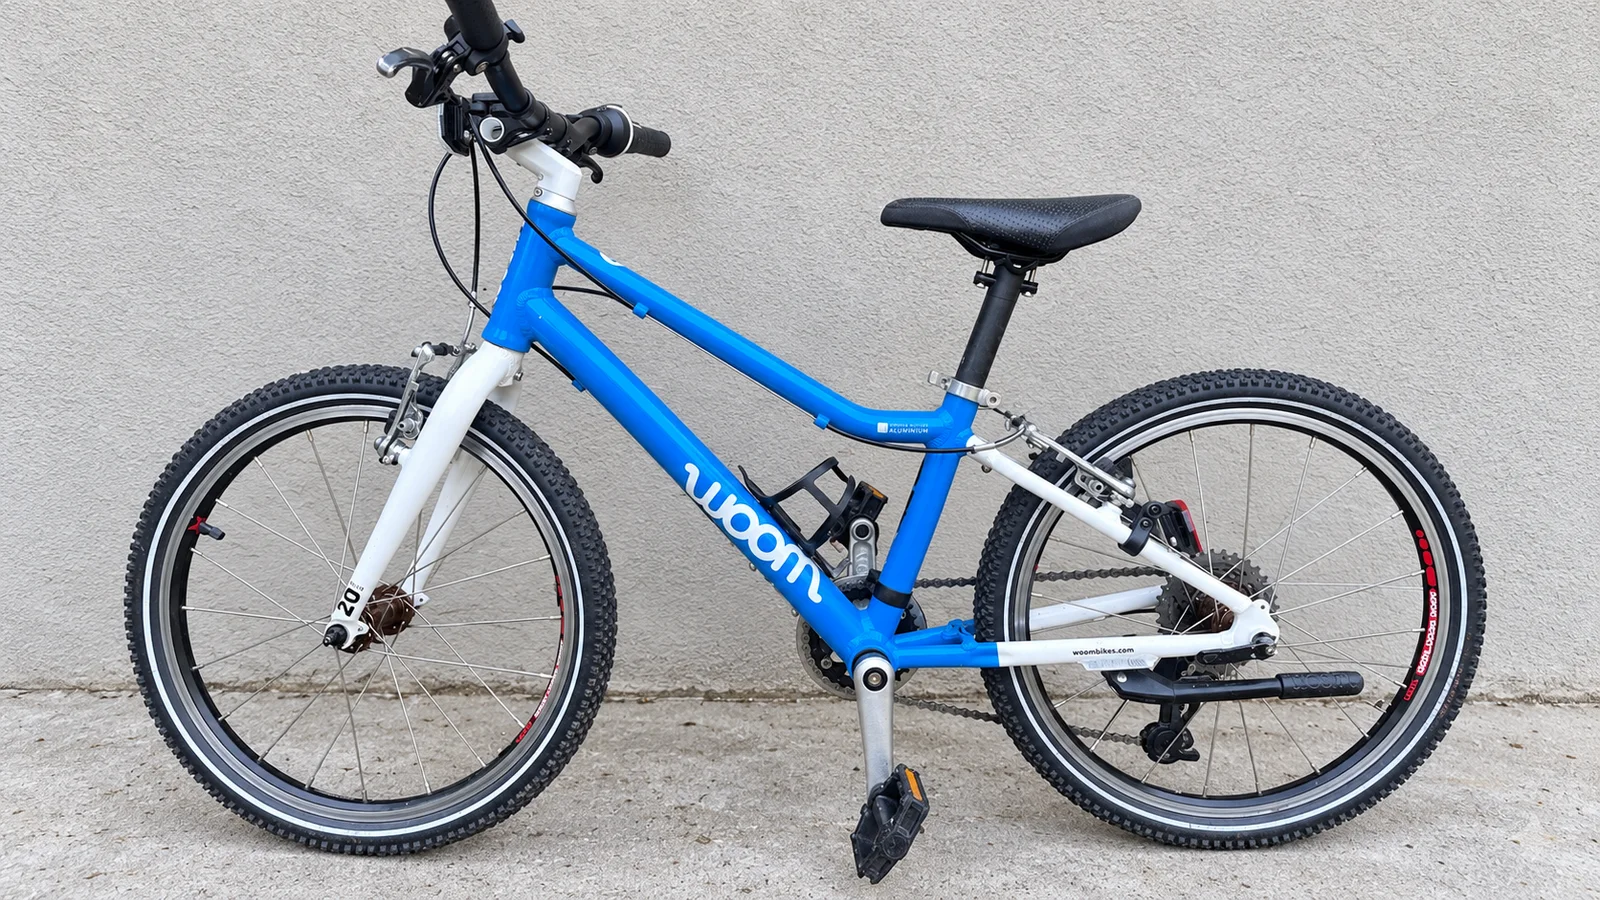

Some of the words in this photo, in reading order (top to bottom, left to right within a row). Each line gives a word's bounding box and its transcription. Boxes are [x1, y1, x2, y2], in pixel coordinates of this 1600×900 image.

[684, 462, 823, 604] woom
[337, 587, 361, 617] 20
[1072, 647, 1135, 656] woombikes.com
